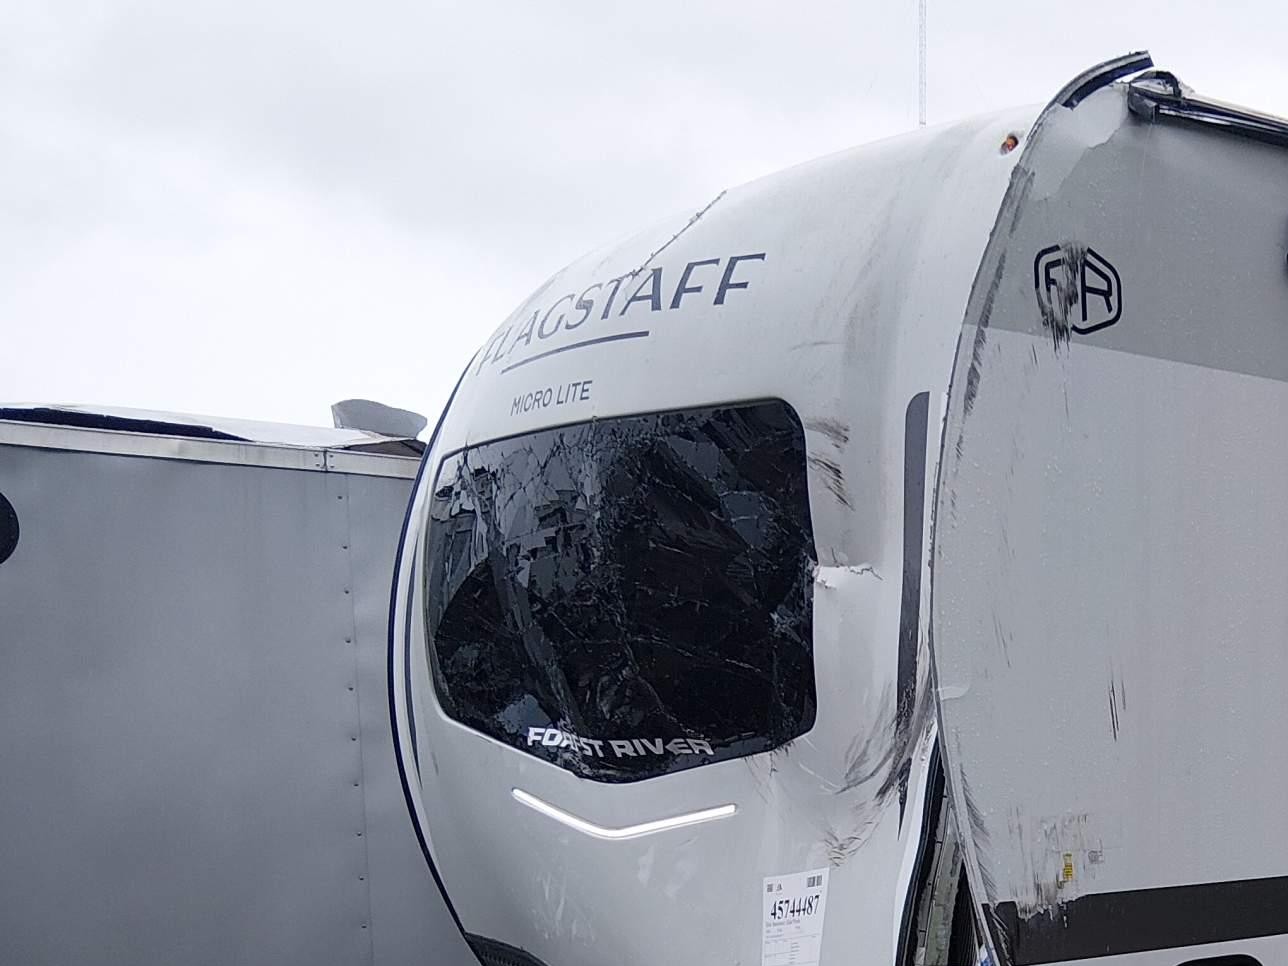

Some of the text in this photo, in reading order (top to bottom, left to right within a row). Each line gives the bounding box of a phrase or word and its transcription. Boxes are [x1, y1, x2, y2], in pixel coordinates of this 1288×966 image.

[475, 252, 767, 376] FLAGSTAFF
[511, 380, 593, 416] MICRO LITE
[608, 738, 715, 758] RIVER
[770, 894, 821, 920] 45744487
